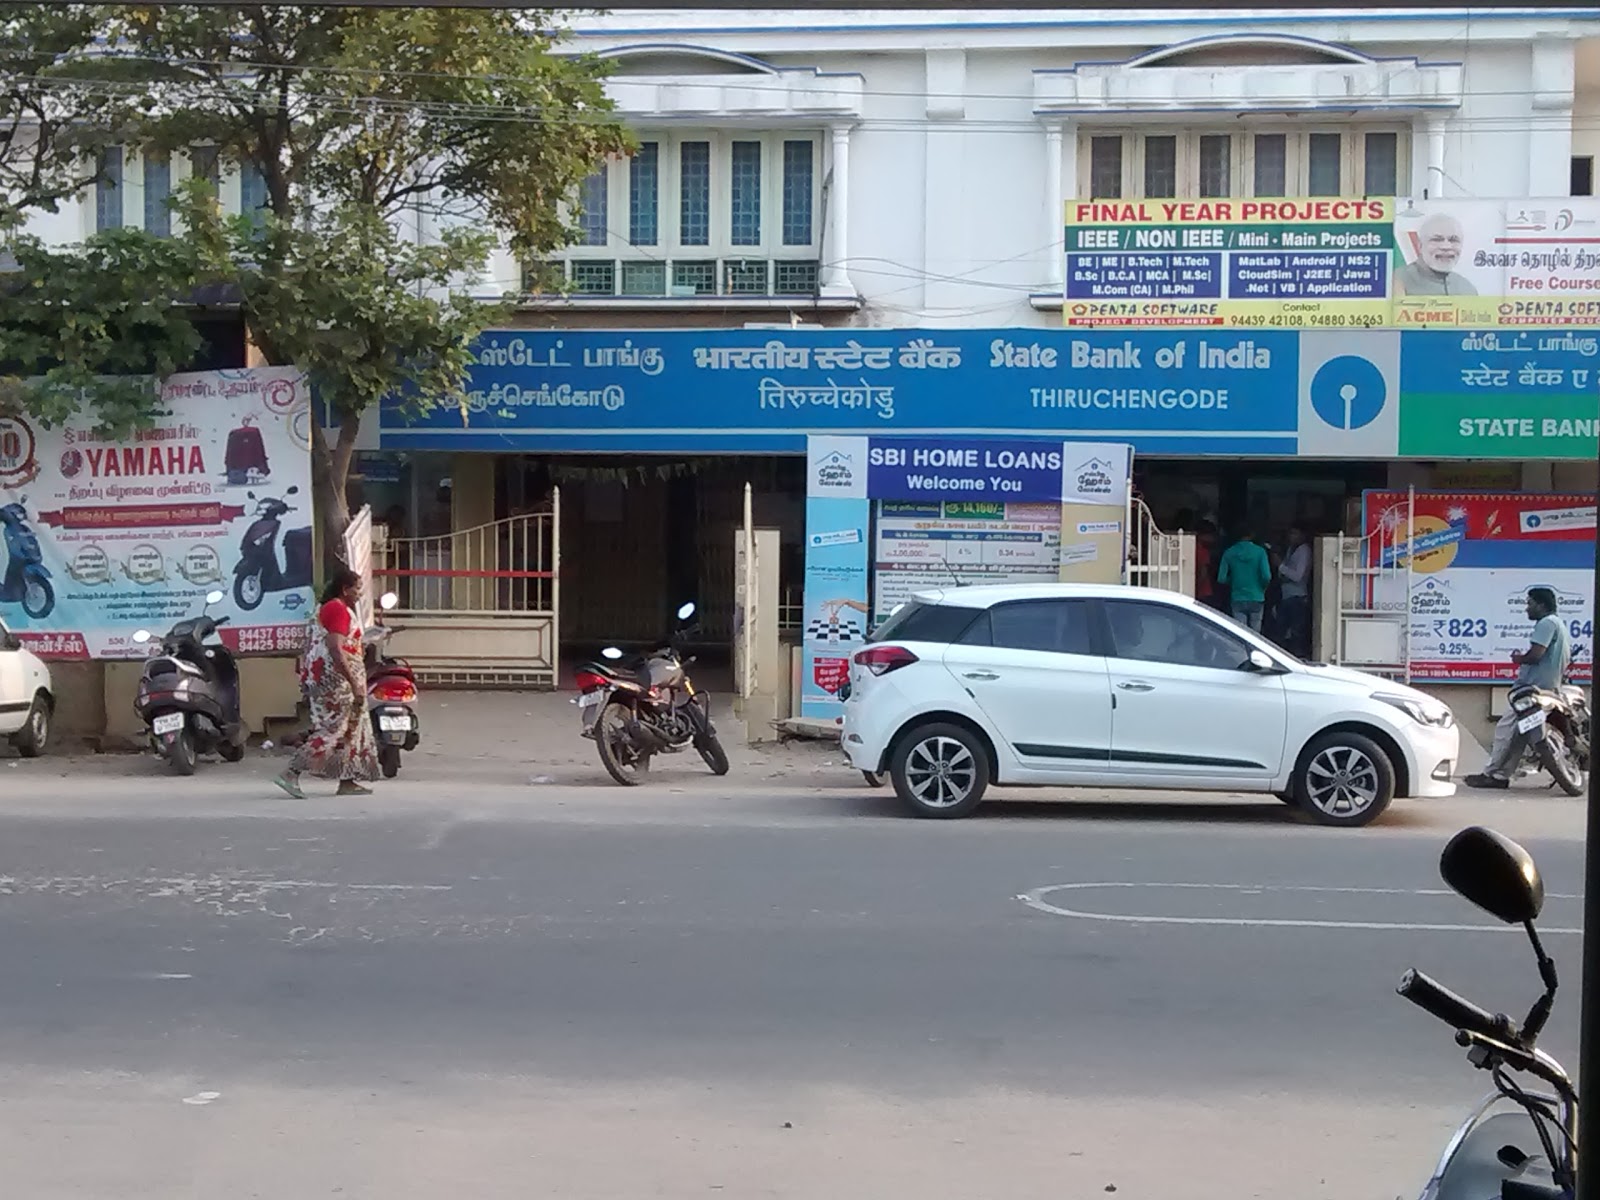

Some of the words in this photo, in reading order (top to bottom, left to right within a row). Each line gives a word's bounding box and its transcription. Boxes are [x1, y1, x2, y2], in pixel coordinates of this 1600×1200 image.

[1076, 203, 1153, 223] FINAL
[1162, 202, 1232, 222] YEAR
[1241, 200, 1385, 221] PROJECTS
[1077, 229, 1119, 248] IEEE
[1135, 229, 1177, 248] NON
[1181, 228, 1224, 247] IEEE
[1238, 232, 1269, 247] Mini
[1281, 232, 1317, 247] Main
[1320, 232, 1382, 249] Projects
[1078, 257, 1093, 267] BE
[1101, 257, 1118, 267] ME
[1128, 256, 1163, 267] B.Tech
[1172, 256, 1210, 267] M.Tech
[1238, 256, 1281, 266] MatLab
[1291, 255, 1337, 266] Android
[1347, 255, 1371, 265] NS2
[1473, 249, 1519, 268] இலவச
[1521, 248, 1572, 272] தொழில்
[1074, 271, 1098, 281] B.Sc
[1107, 270, 1136, 281] B.C.A
[1145, 270, 1170, 281] MCA
[1238, 269, 1292, 280] CloudSim
[1303, 269, 1332, 279] J2EE
[1343, 269, 1371, 279] Java
[1092, 284, 1128, 295] M.Com
[1130, 284, 1152, 296] (CA)
[1162, 284, 1195, 295] M.Phil
[1279, 283, 1296, 293] VB
[1306, 282, 1372, 294] Application
[1510, 276, 1543, 290] Free
[1089, 303, 1138, 316] PENTA
[1142, 303, 1219, 316] SOFTWARE
[1282, 303, 1321, 312] Contact
[1515, 302, 1563, 315] PENTA
[1076, 318, 1128, 326] PROJECT
[1230, 315, 1266, 327] 94439
[1310, 315, 1346, 326] 94880
[1348, 315, 1384, 326] 36263
[1397, 309, 1454, 323] ACME
[1500, 317, 1566, 325] COMPUTER
[1461, 331, 1533, 352] ஸ்டேட்
[1538, 331, 1598, 357] பாங்கு
[480, 339, 571, 368] ஸ்டேட்
[583, 338, 665, 376] பாங்கு
[694, 340, 811, 370] भारतीय
[814, 340, 894, 370] स्टेट
[898, 339, 962, 370] बैंक
[989, 338, 1058, 369] State
[1070, 340, 1142, 370] Bank
[1155, 340, 1186, 370] of
[1199, 340, 1271, 370] India
[1460, 362, 1511, 387] स्टेट
[1518, 361, 1564, 386] बैंक
[1029, 388, 1229, 410] THIRUCHENGODE
[1459, 418, 1535, 437] STATE
[85, 444, 206, 478] YAMAHA
[869, 447, 906, 467] SBI
[913, 448, 979, 469] HOME
[984, 450, 1061, 471] LOANS
[906, 474, 986, 491] Welcome
[988, 476, 1022, 492] You
[239, 627, 274, 641] 94437
[239, 639, 274, 653] 94425
[1439, 642, 1472, 655] 9.25%
